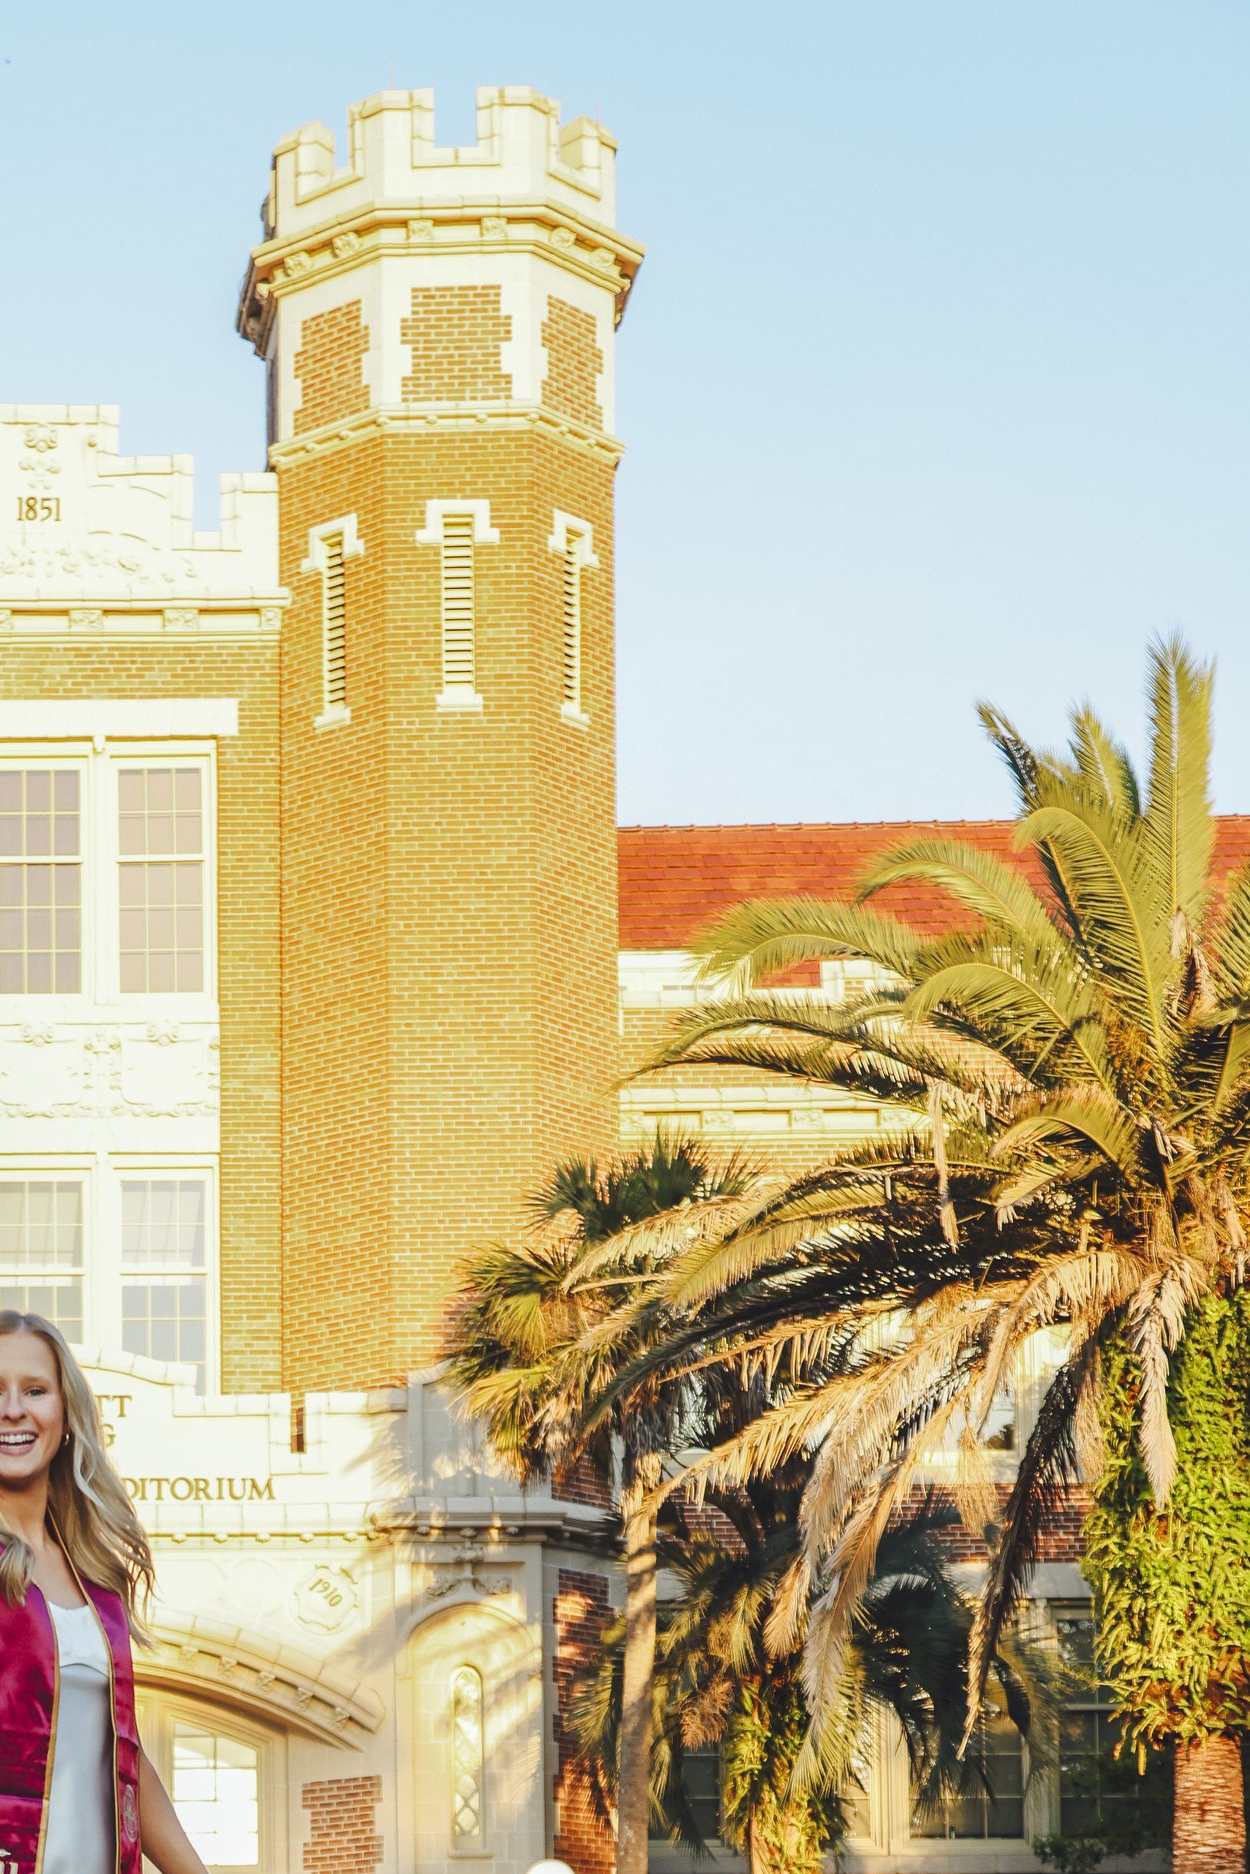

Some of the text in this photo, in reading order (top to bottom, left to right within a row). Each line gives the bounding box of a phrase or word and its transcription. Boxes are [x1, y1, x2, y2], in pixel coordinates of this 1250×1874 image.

[16, 496, 62, 522] 1851
[121, 1477, 276, 1501] DITORIUM
[308, 1578, 343, 1608] 1910
